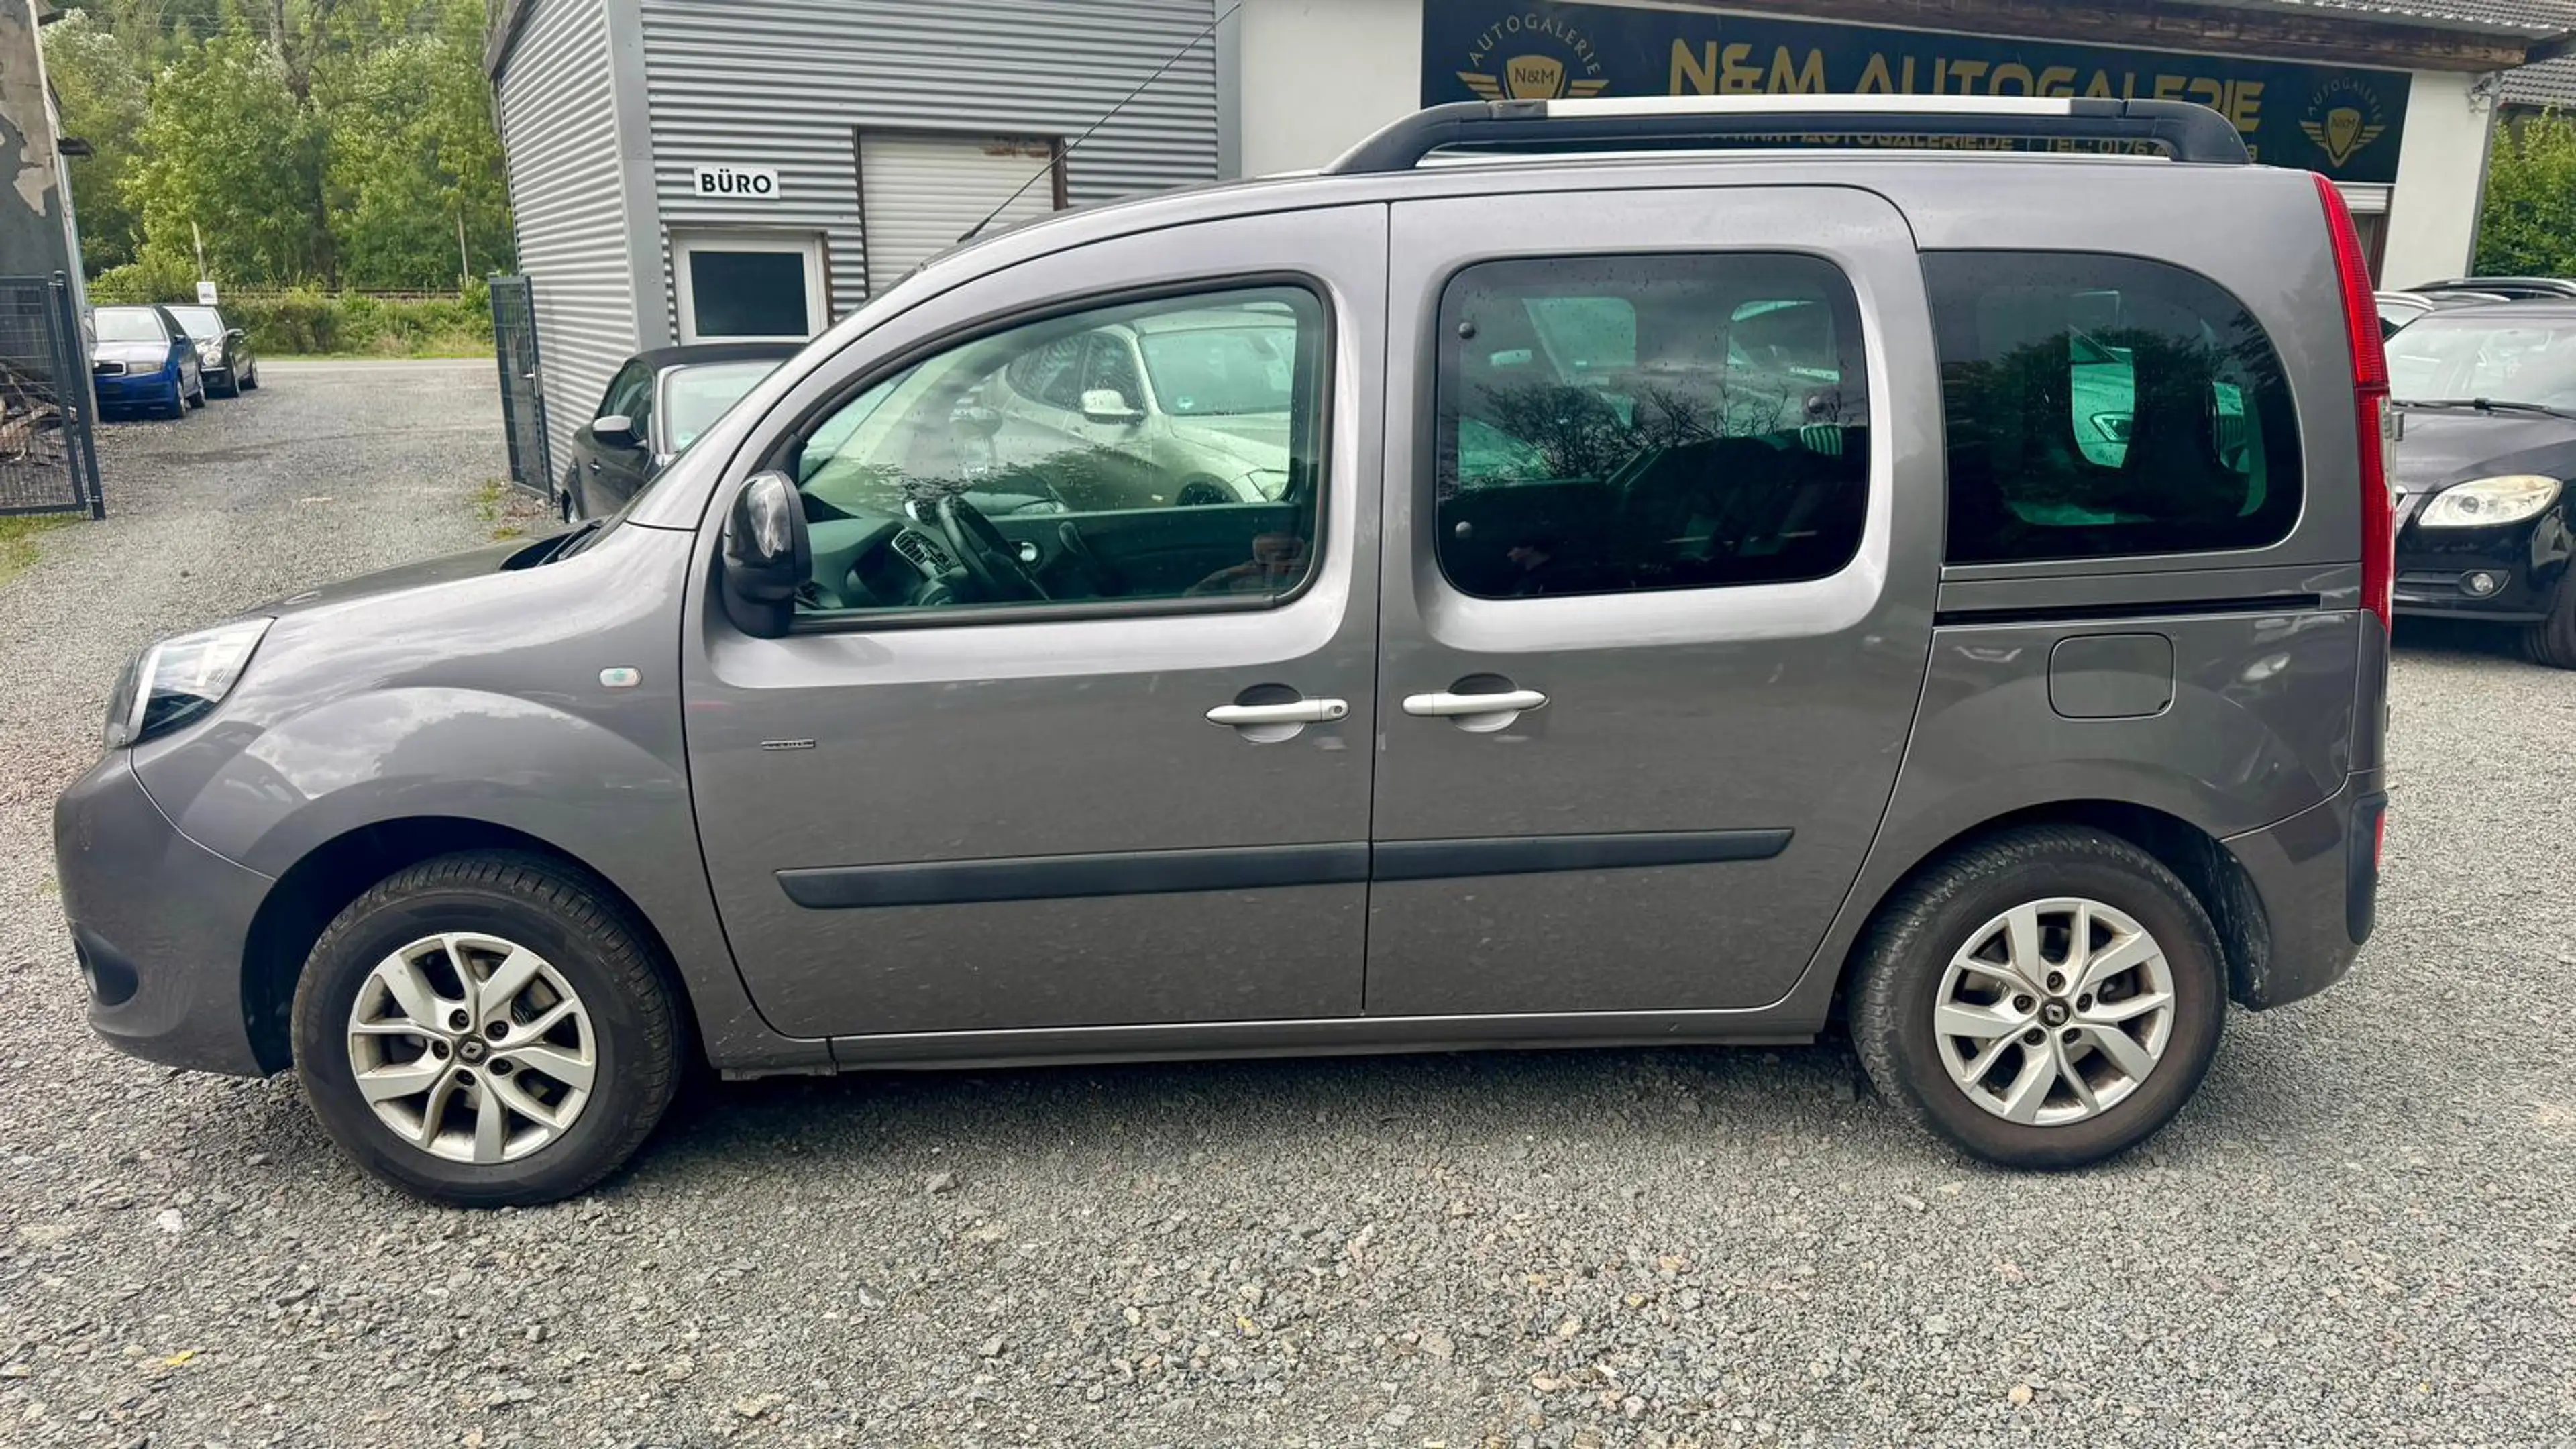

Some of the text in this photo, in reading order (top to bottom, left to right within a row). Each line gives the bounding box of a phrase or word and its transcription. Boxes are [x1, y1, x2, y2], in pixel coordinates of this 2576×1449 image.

[1469, 13, 1601, 75] AUTOGALERIE
[1514, 68, 1555, 84] N&M
[1670, 38, 1825, 95] N&M
[701, 168, 771, 193] BÜRO
